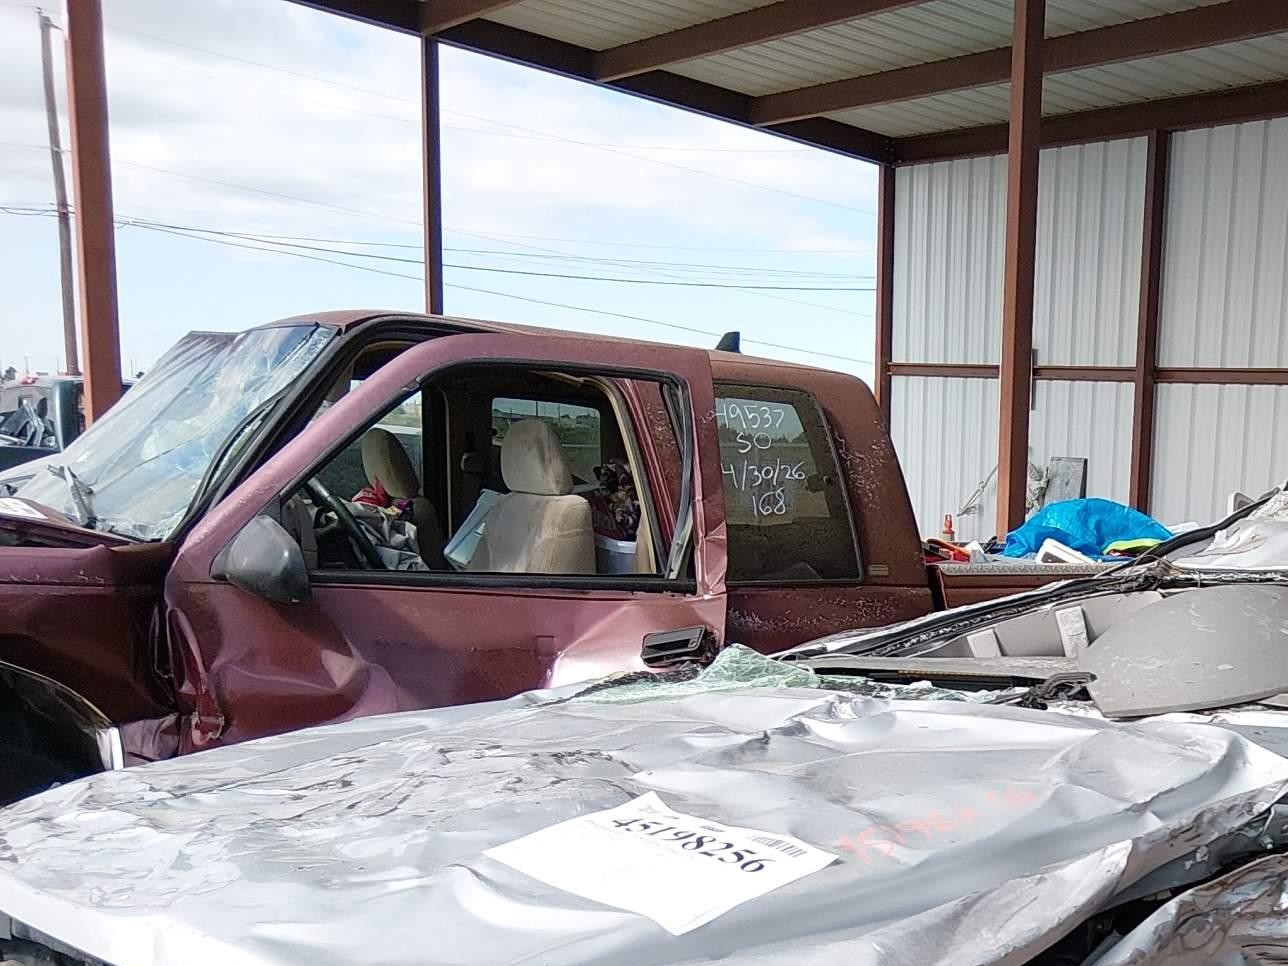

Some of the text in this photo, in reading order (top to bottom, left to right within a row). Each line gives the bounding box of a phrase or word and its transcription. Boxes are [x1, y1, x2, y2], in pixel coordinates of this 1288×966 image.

[720, 458, 806, 491] 4/30/26
[752, 487, 786, 517] 168
[612, 818, 777, 873] 45198256
